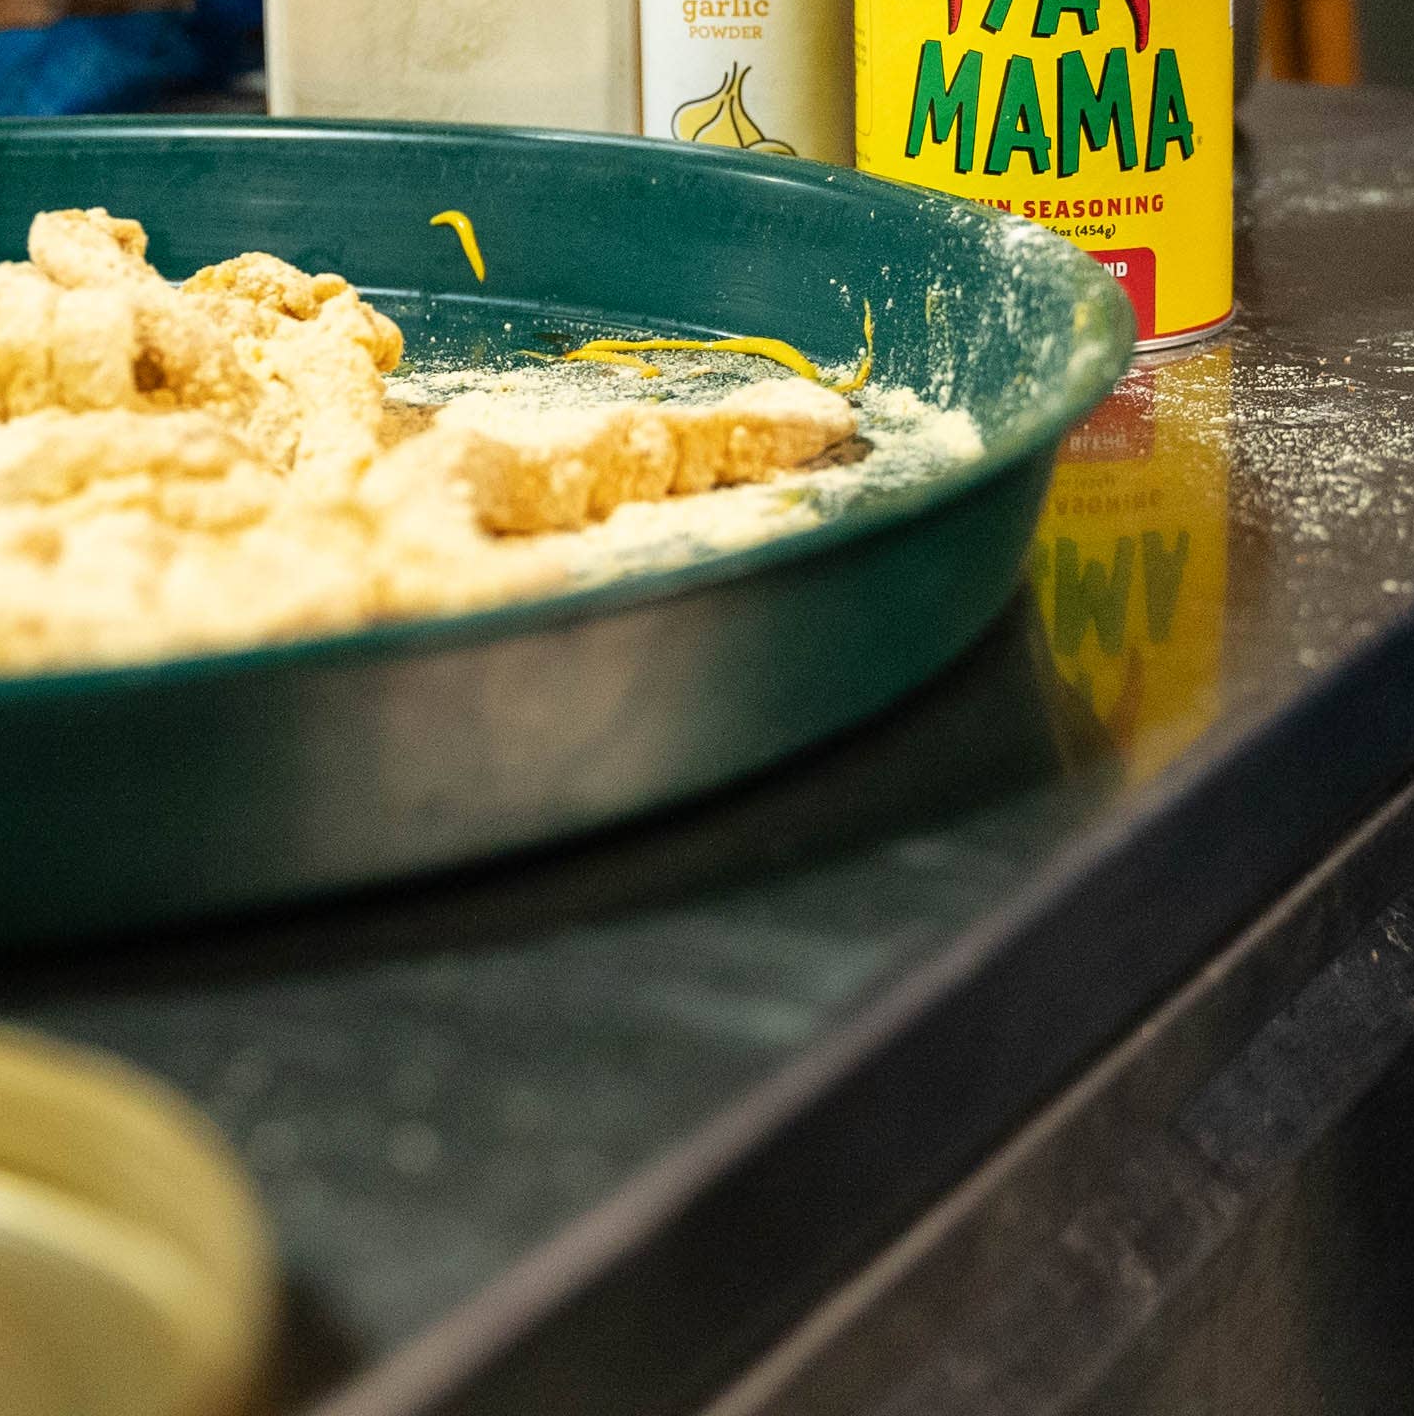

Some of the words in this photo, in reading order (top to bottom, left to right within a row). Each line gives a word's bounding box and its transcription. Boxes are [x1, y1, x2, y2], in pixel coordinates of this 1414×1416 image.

[688, 25, 764, 41] POWDER
[905, 40, 1195, 179] MAMA
[1022, 194, 1164, 219] SEASONING
[1074, 223, 1117, 240] (454g)
